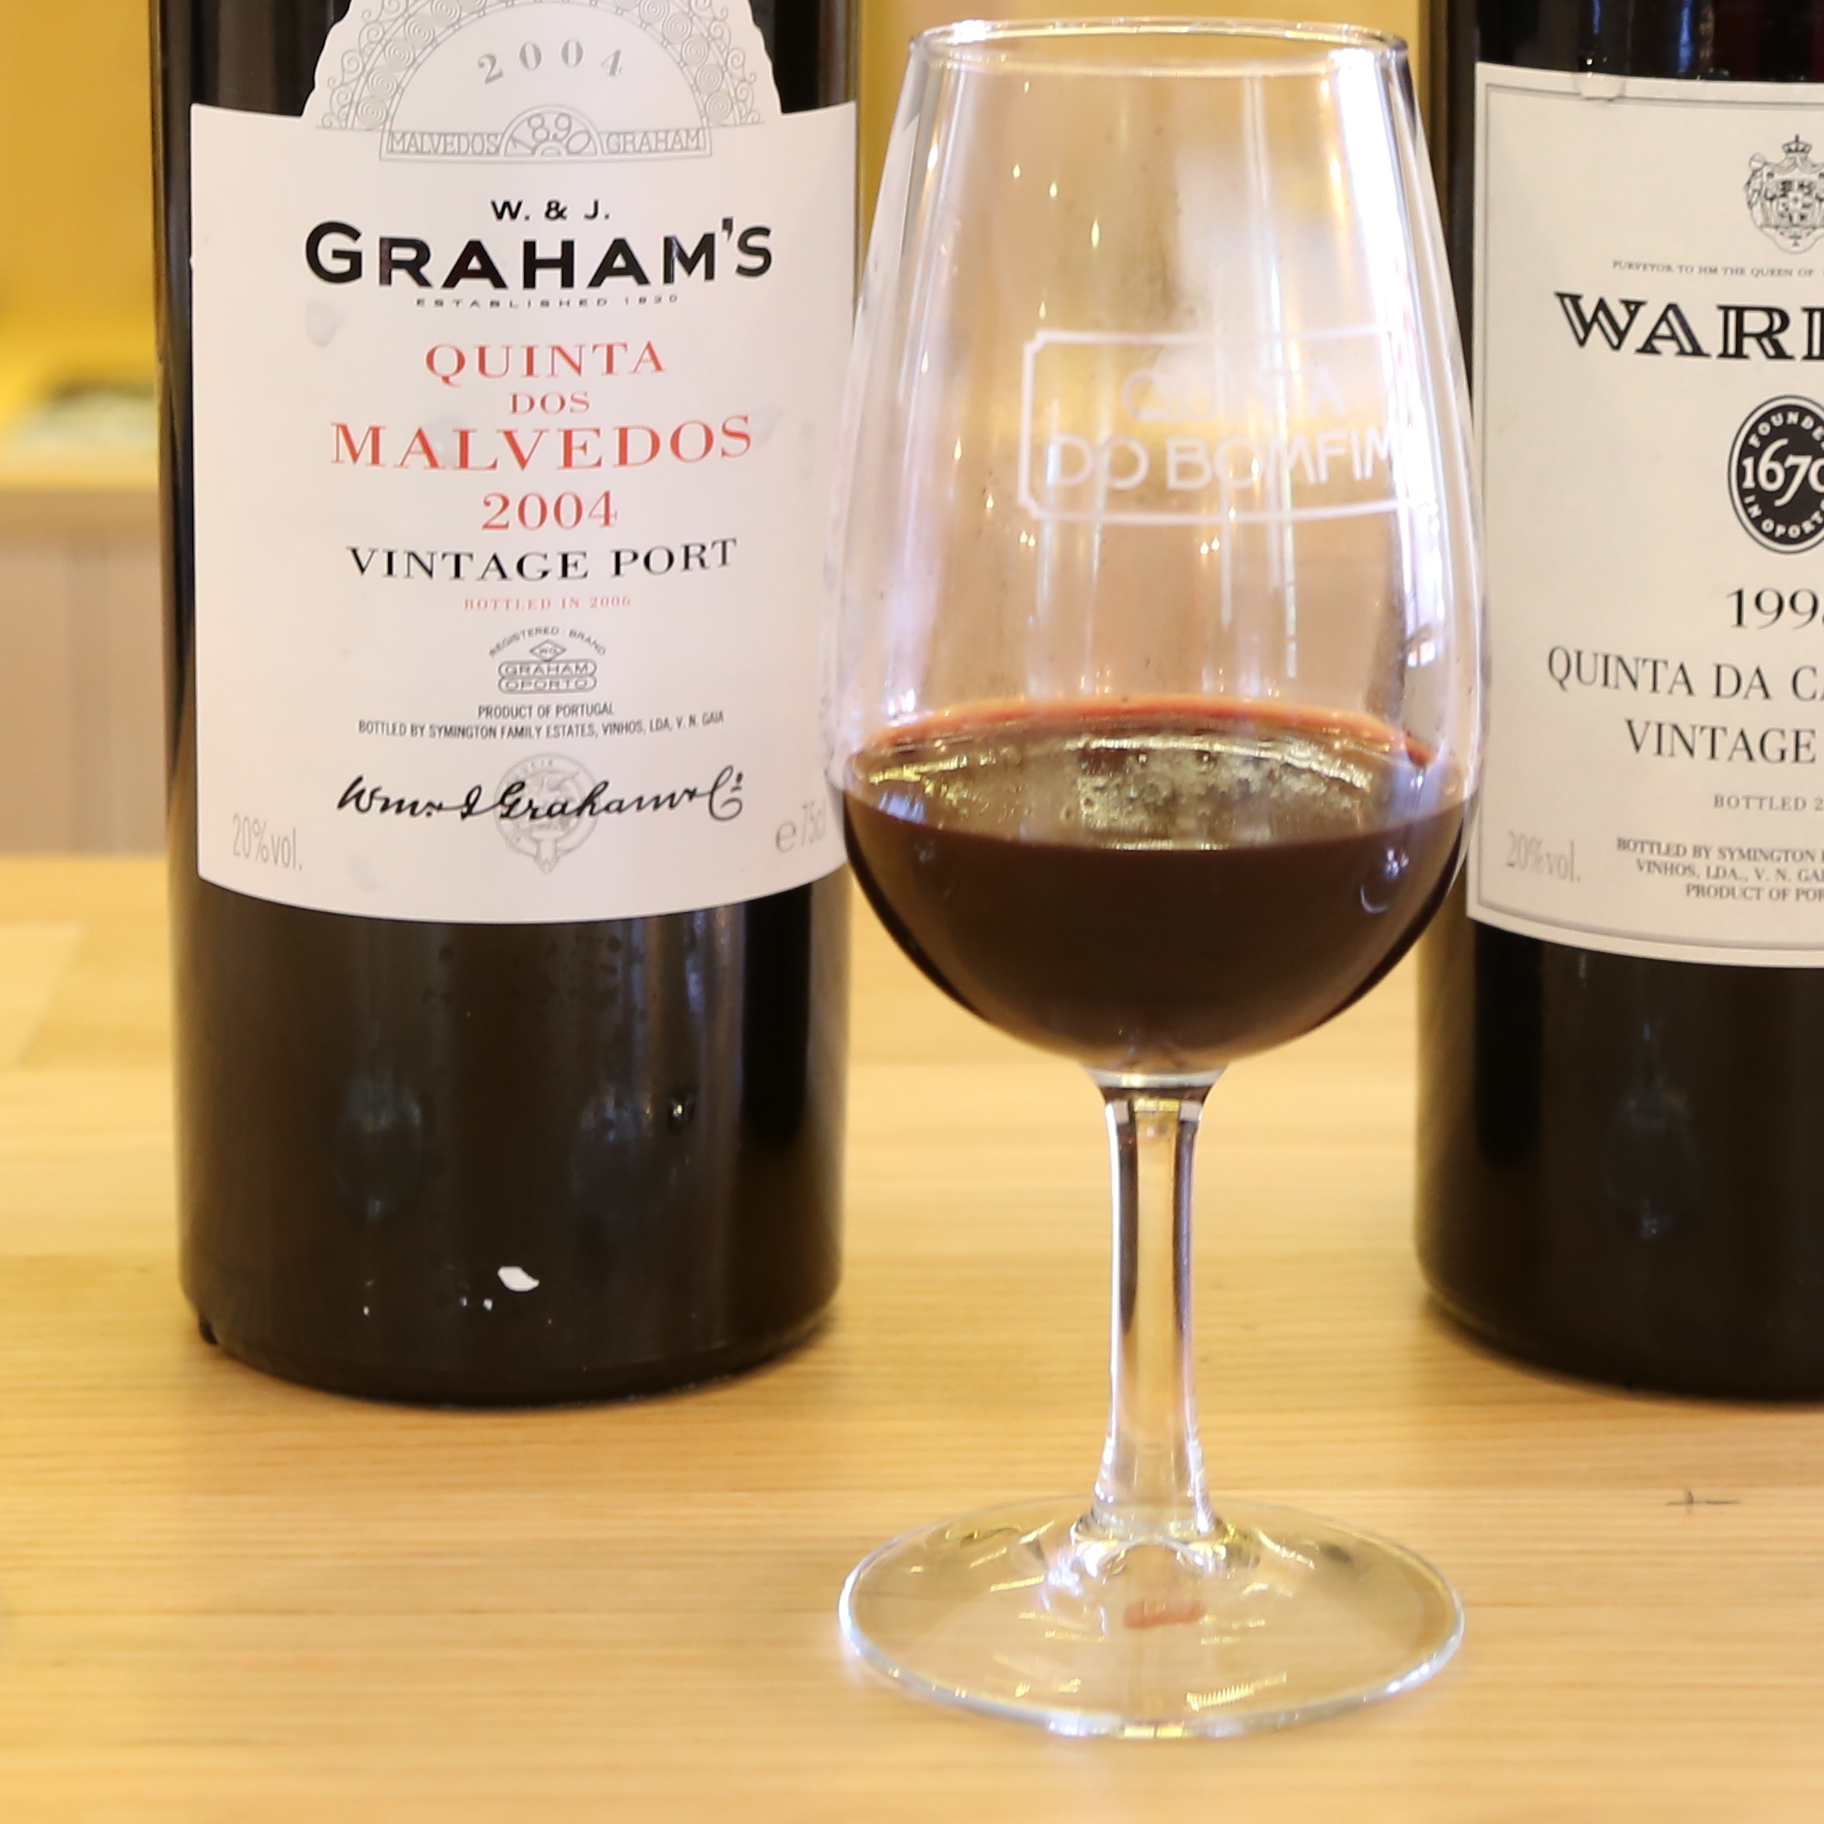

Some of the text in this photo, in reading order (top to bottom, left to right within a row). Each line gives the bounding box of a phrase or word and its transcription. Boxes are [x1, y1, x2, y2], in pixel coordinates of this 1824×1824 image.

[477, 40, 625, 85] 2004
[389, 131, 500, 155] MALVEDOS
[605, 129, 702, 154] GRAHAM
[490, 198, 610, 221] W. & J.
[305, 217, 773, 291] GRAHAM'S
[1677, 264, 1694, 274] TO
[1722, 266, 1746, 276] THE
[1750, 267, 1793, 278] QUEEN
[1797, 268, 1814, 277] OF
[416, 297, 609, 309] ESTABLISHED
[424, 341, 667, 385] QUINTA
[509, 392, 591, 415] DOS
[330, 415, 754, 472] MALVEDOS
[1047, 432, 1150, 492] DO
[480, 491, 619, 531] 2004
[1743, 494, 1763, 519] IN
[346, 537, 739, 582] VINTAGE PORT
[464, 598, 552, 611] BOTTLED
[561, 597, 580, 609] IN
[489, 626, 607, 658] REGISTERED BRAND
[504, 662, 590, 676] GRAHAM
[1547, 645, 1696, 697] QUINTA
[1714, 663, 1773, 701] DA
[504, 678, 589, 691] OPORTO
[478, 702, 615, 719] PRODUCT OF PORTUGAL
[358, 719, 408, 736] BOTTLED
[410, 724, 426, 737] BY
[428, 724, 498, 739] SYMINGTON
[500, 725, 543, 739] FAMILY
[546, 724, 600, 738] ESTATES,
[602, 719, 647, 736] VINHOS,
[702, 710, 725, 726] GAIA
[1624, 719, 1817, 765] VINTAGE
[1713, 794, 1808, 812] BOTTLED
[1617, 837, 1688, 858] BOTTLED
[1692, 845, 1713, 860] BY
[1717, 846, 1816, 863] SYMINGTON
[1754, 867, 1770, 882] V.
[1776, 868, 1792, 883] N.
[1685, 883, 1764, 901] PRODUCT
[1768, 887, 1791, 902] OF
